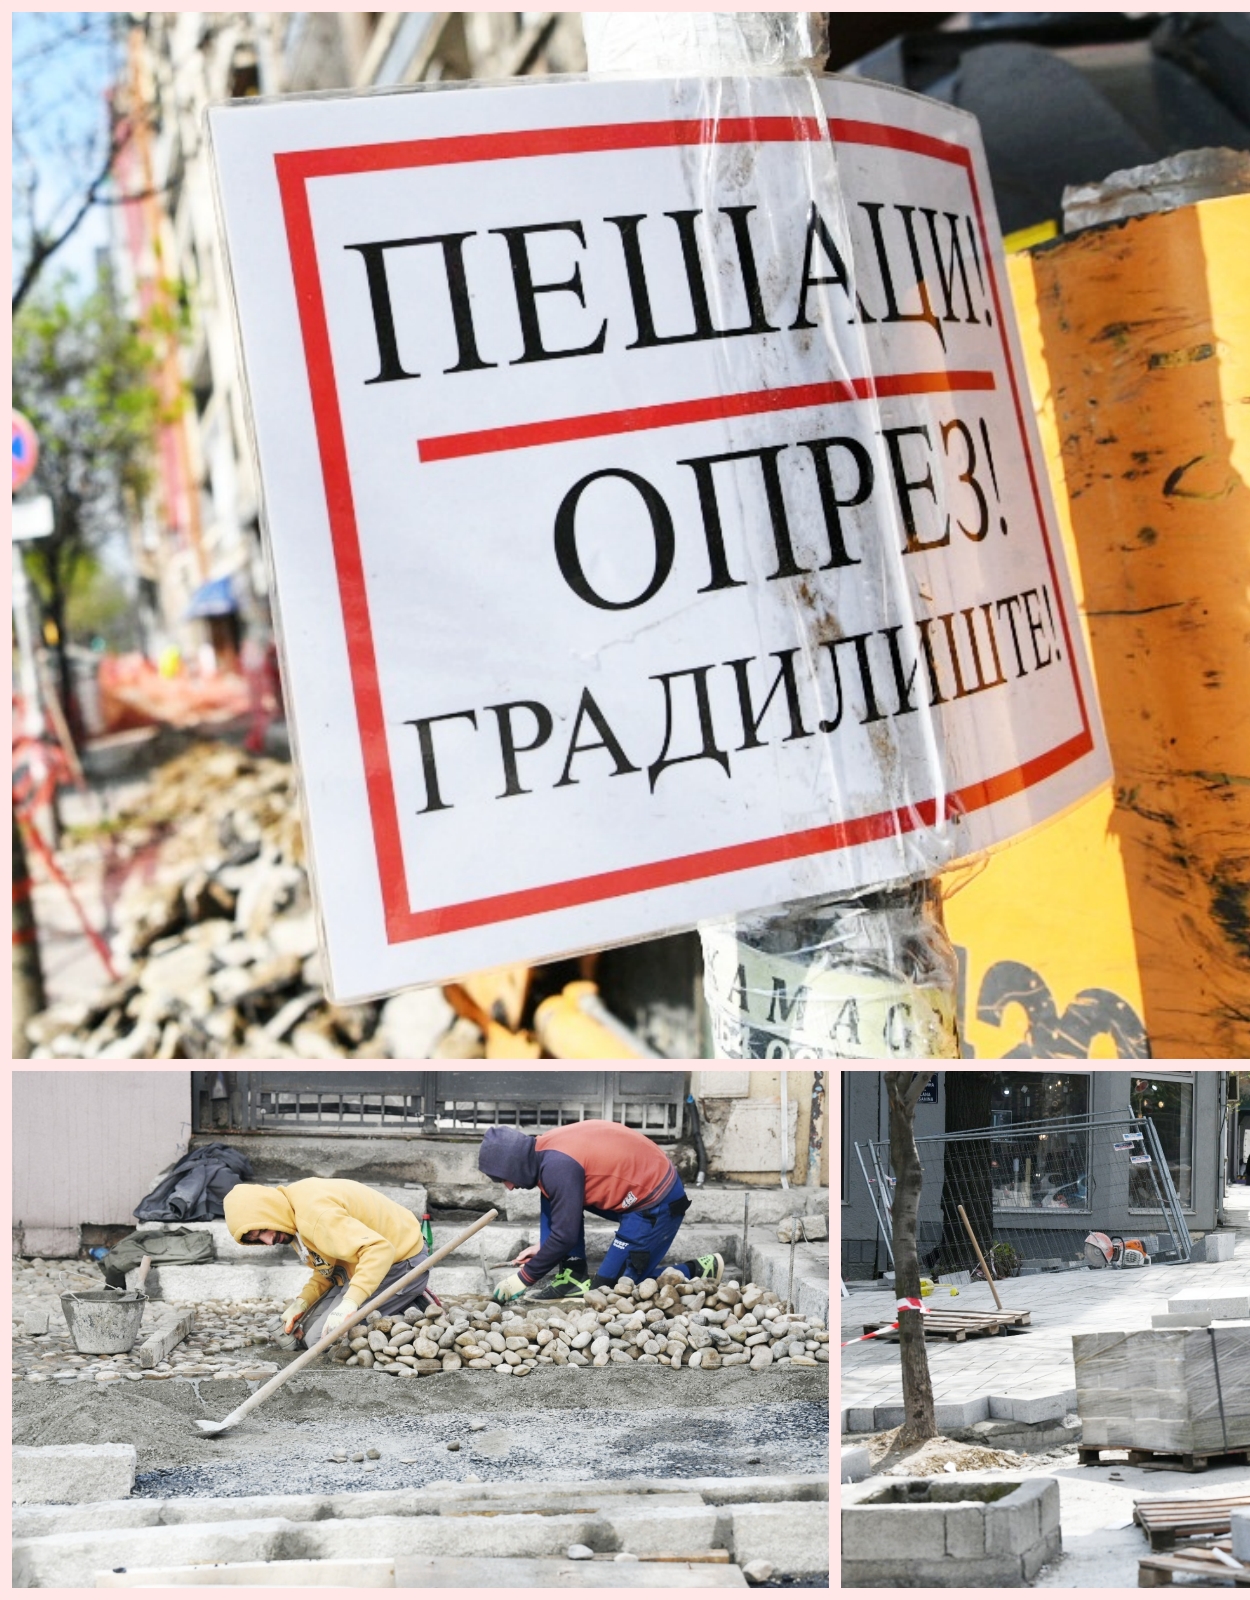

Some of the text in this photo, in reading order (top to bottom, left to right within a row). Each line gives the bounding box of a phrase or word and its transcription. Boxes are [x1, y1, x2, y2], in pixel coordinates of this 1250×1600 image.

[343, 200, 993, 385] ПЕШАЦИ!
[554, 417, 1008, 611] ОПРЕЗ!
[403, 584, 1062, 814] ГРАДИЛИШТЕ!
